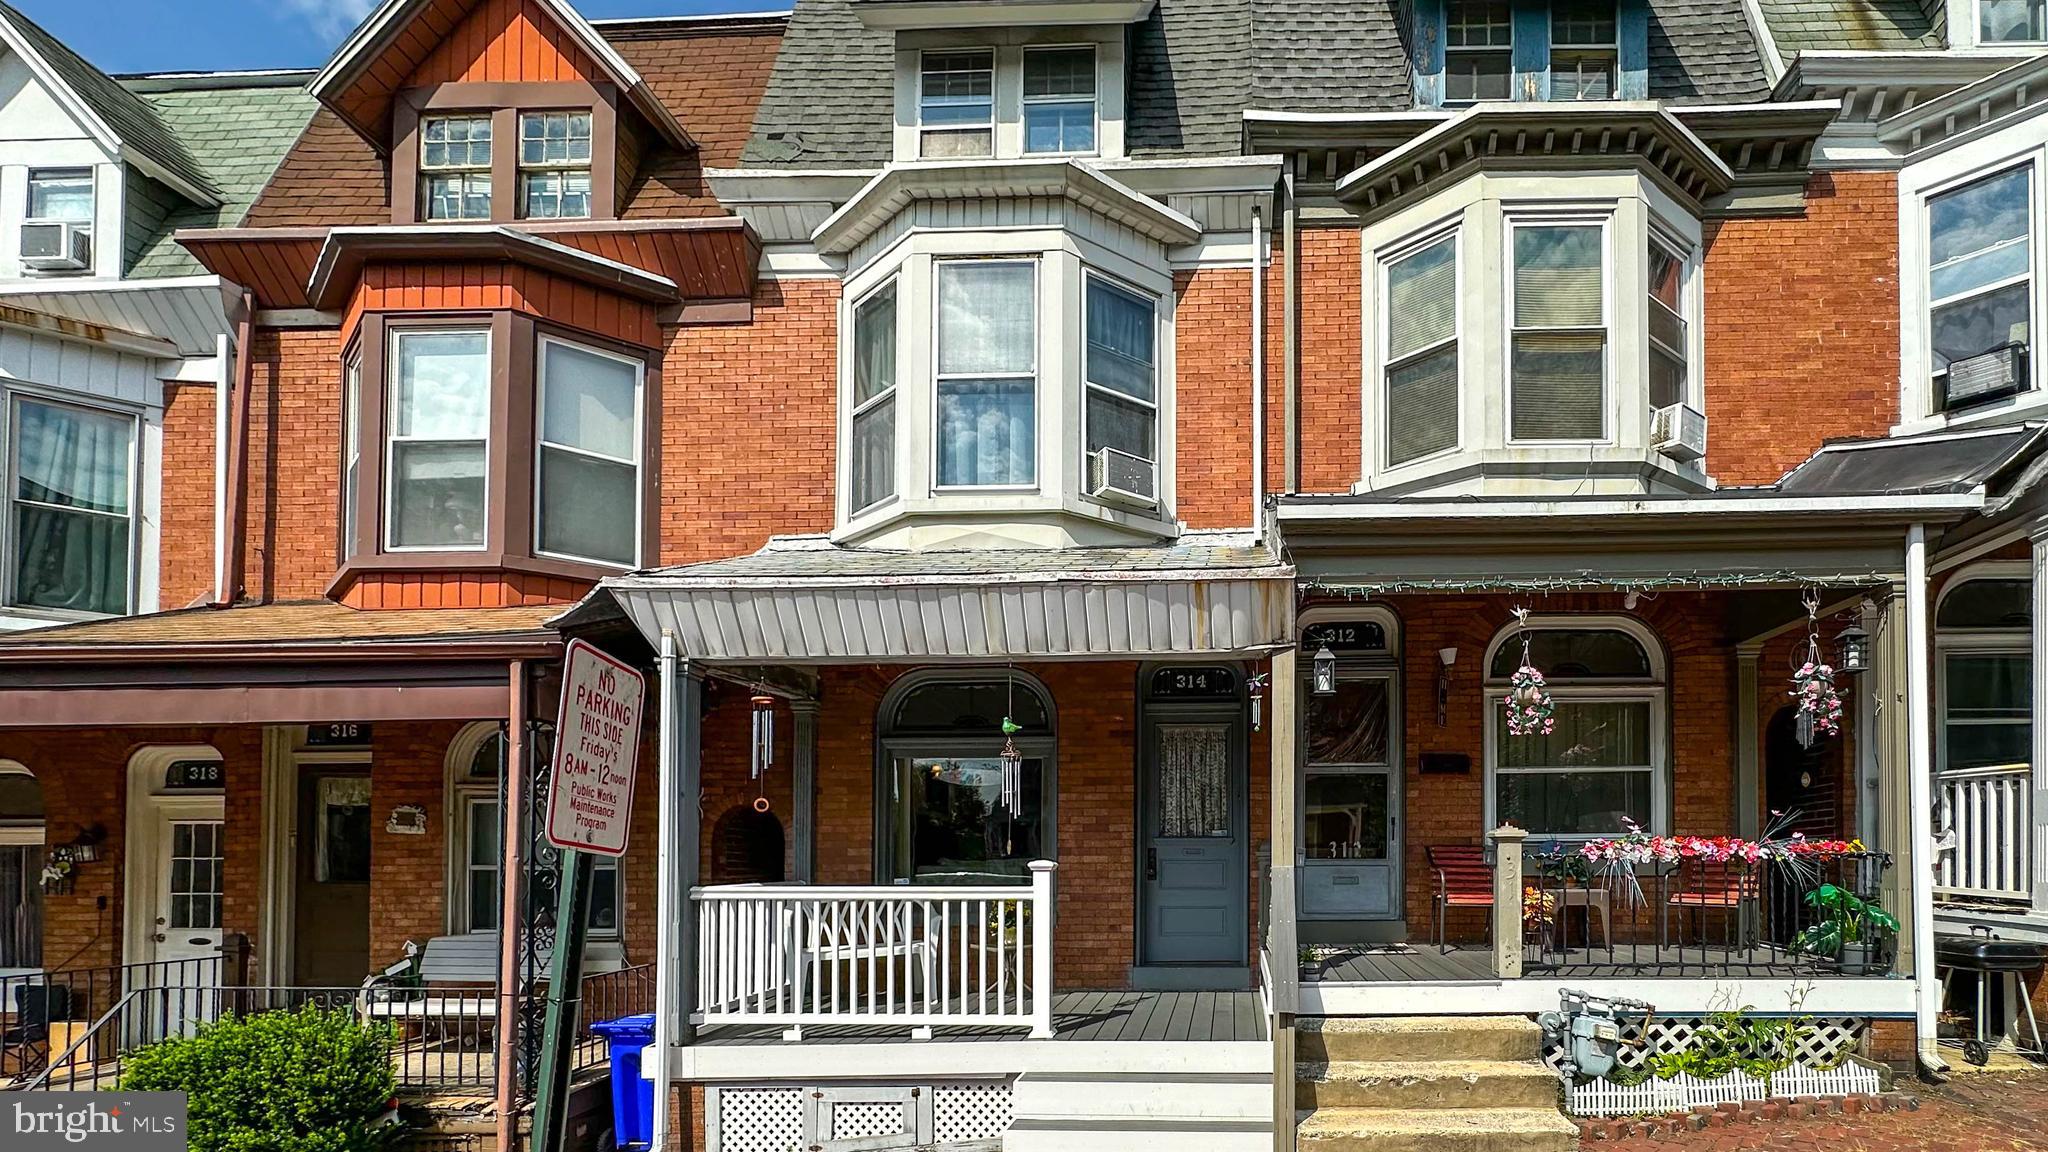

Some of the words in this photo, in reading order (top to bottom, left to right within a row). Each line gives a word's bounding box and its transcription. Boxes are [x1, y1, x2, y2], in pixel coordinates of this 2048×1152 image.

[1325, 629, 1355, 642] 312
[598, 669, 616, 695] NO
[1176, 675, 1207, 688] 314
[576, 684, 631, 726] PARKING
[331, 724, 358, 737] 316
[580, 712, 601, 736] THIS
[602, 721, 624, 745] SIDE
[580, 736, 618, 763] Friday's
[189, 767, 218, 780] 318
[571, 781, 595, 798] Public
[597, 788, 617, 804] Works
[569, 797, 615, 818] Maintenance
[575, 813, 607, 831] Program
